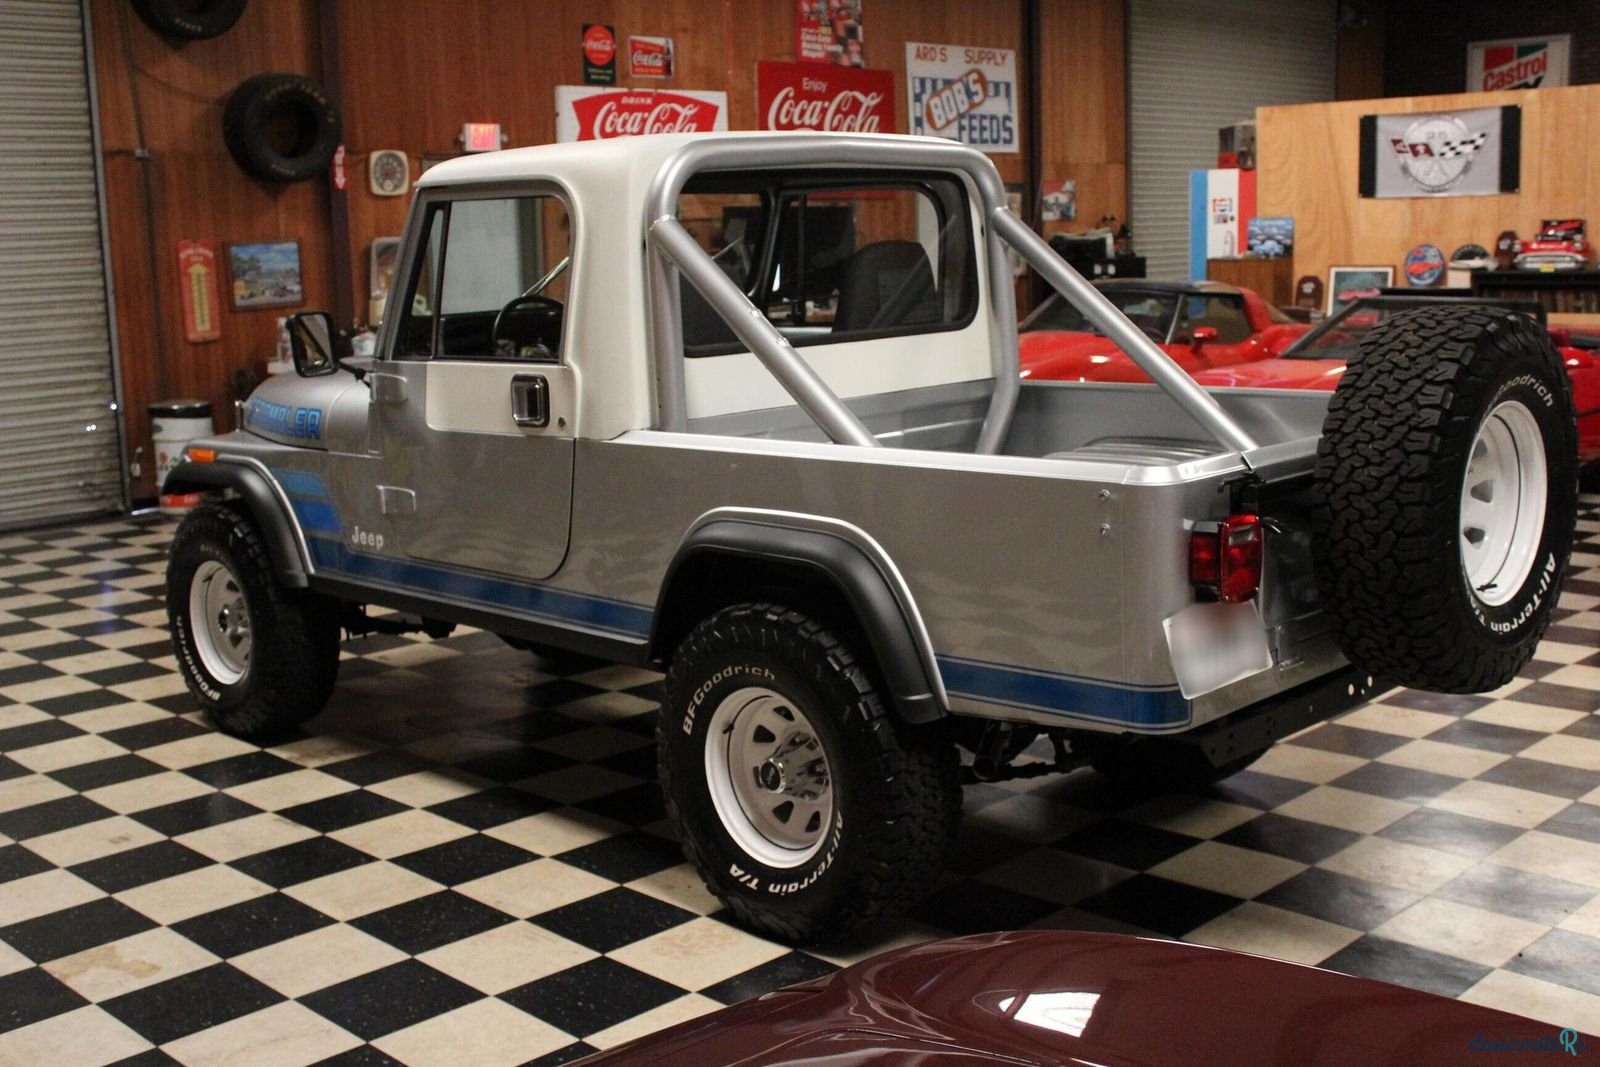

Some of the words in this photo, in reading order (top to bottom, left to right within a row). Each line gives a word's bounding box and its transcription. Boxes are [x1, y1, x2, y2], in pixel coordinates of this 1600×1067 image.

[964, 48, 1008, 65] SUPPLY
[1483, 51, 1547, 92] Castrol
[802, 77, 828, 92] Enjoy
[621, 96, 653, 105] DRINK
[768, 87, 884, 132] Coca-Cola
[929, 72, 985, 129] BOB'S
[958, 114, 1014, 144] FEEDS
[351, 526, 385, 549] Jeep
[682, 664, 776, 736] BFGoodrich
[768, 810, 844, 896] All-Terrain
[729, 863, 759, 891] T/A
